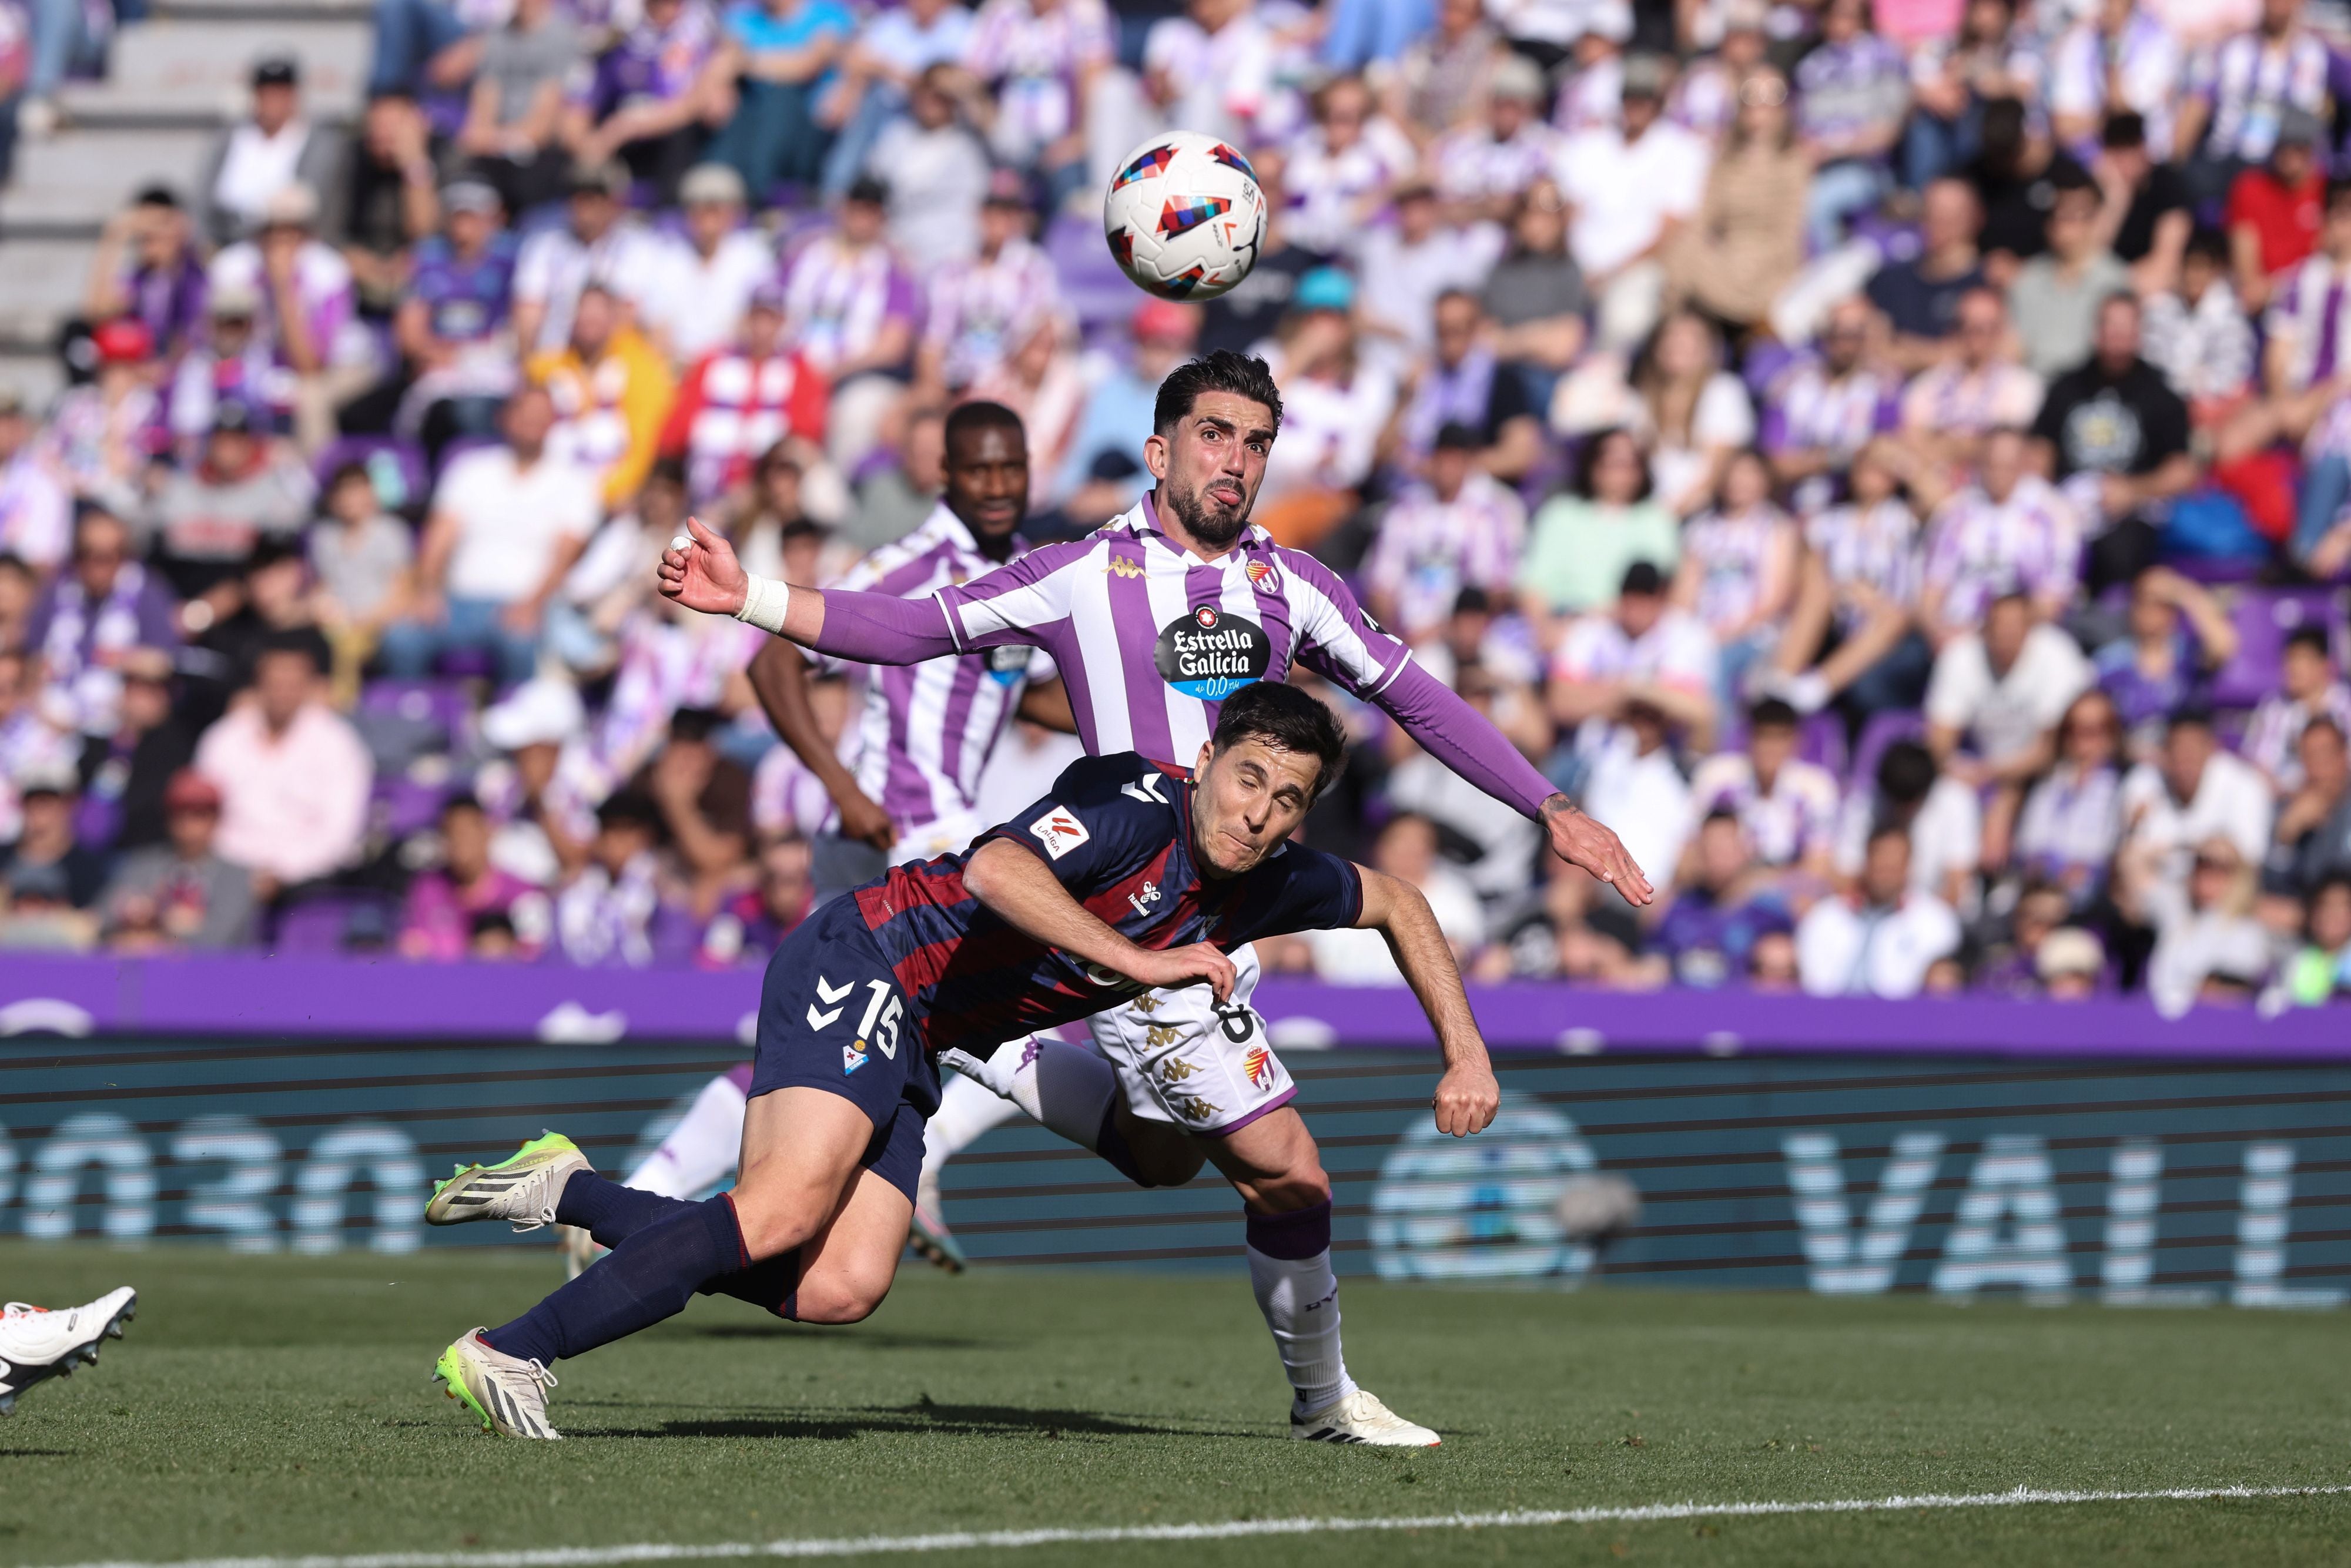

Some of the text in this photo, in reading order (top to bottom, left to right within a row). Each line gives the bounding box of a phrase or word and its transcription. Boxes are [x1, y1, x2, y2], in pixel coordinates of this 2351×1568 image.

[1174, 629, 1253, 652] Estrella
[1179, 651, 1250, 676] Galicia
[1207, 675, 1228, 696] 0,0
[1037, 826, 1060, 852] LALIGA
[883, 900, 895, 917] BEECOOL
[1127, 893, 1150, 917] hummel
[857, 979, 903, 1060] 15
